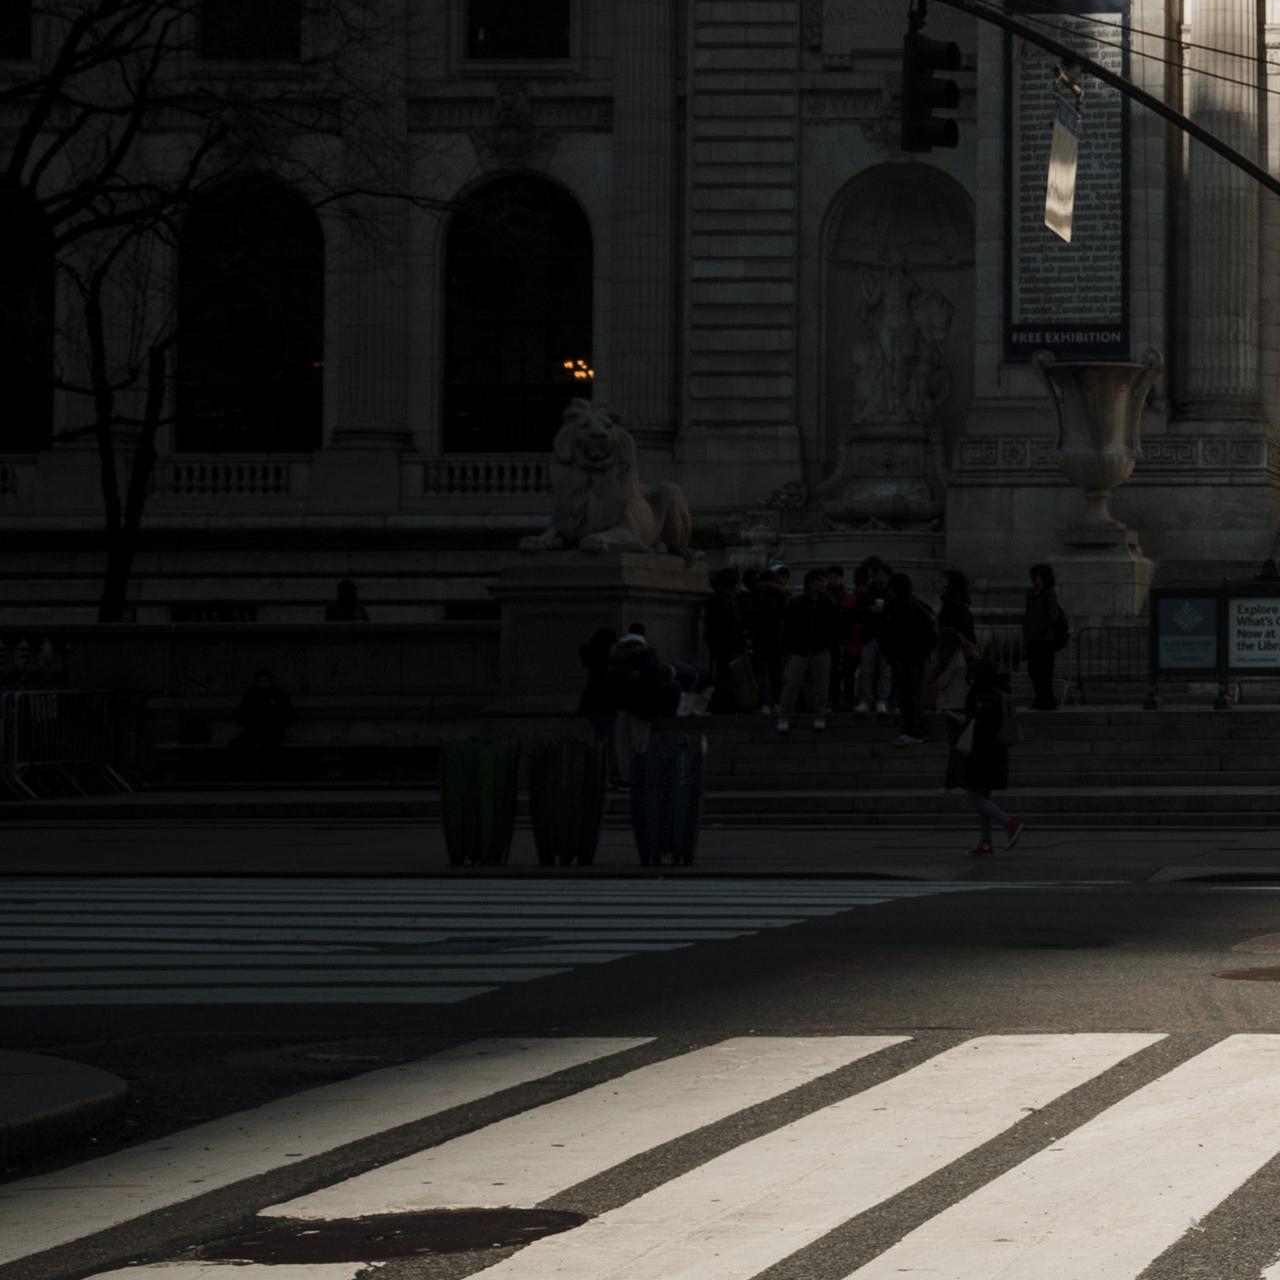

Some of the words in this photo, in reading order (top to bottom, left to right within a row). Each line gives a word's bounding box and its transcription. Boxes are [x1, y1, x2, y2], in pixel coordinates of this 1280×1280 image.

[1011, 332, 1041, 344] FREE
[1044, 332, 1121, 344] EXHIBITION
[1237, 604, 1279, 616] Explore
[1236, 616, 1273, 627] What's
[1236, 629, 1262, 639] Now
[1264, 630, 1276, 639] at
[1236, 641, 1256, 651] the
